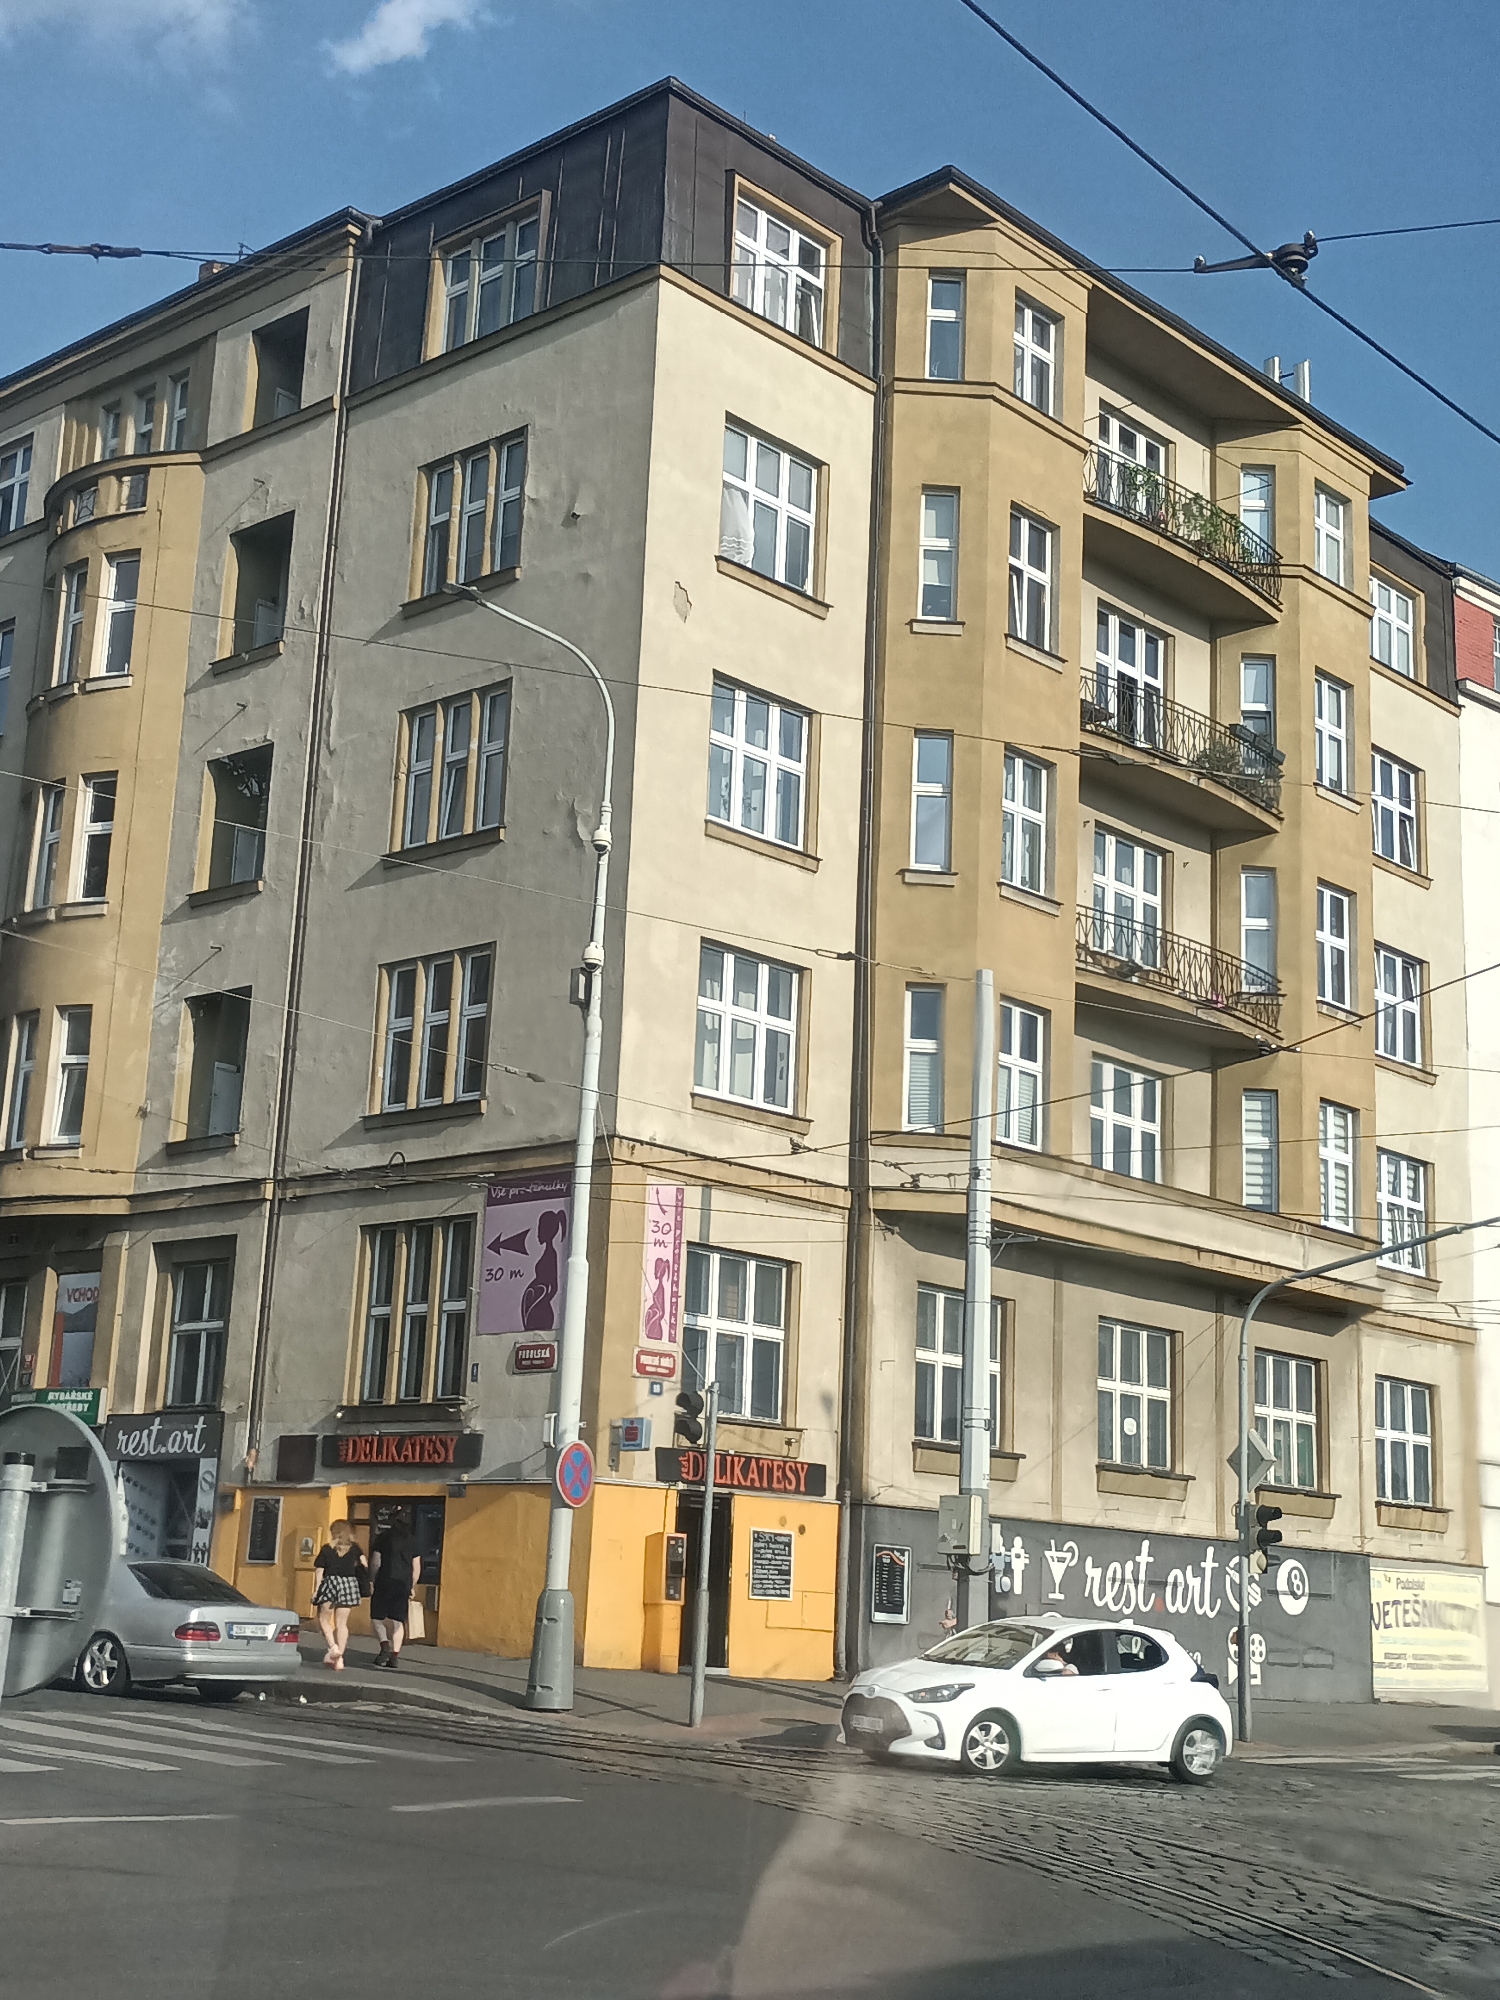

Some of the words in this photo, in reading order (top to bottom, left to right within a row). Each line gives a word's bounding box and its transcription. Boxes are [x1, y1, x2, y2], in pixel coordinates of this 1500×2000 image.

[651, 1220, 672, 1236] 30
[653, 1237, 668, 1248] m
[484, 1267, 504, 1282] 30
[509, 1268, 525, 1280] m
[67, 1286, 99, 1303] VCHOD
[346, 1435, 458, 1463] DELIKATESY
[1084, 1539, 1221, 1619] rest.art
